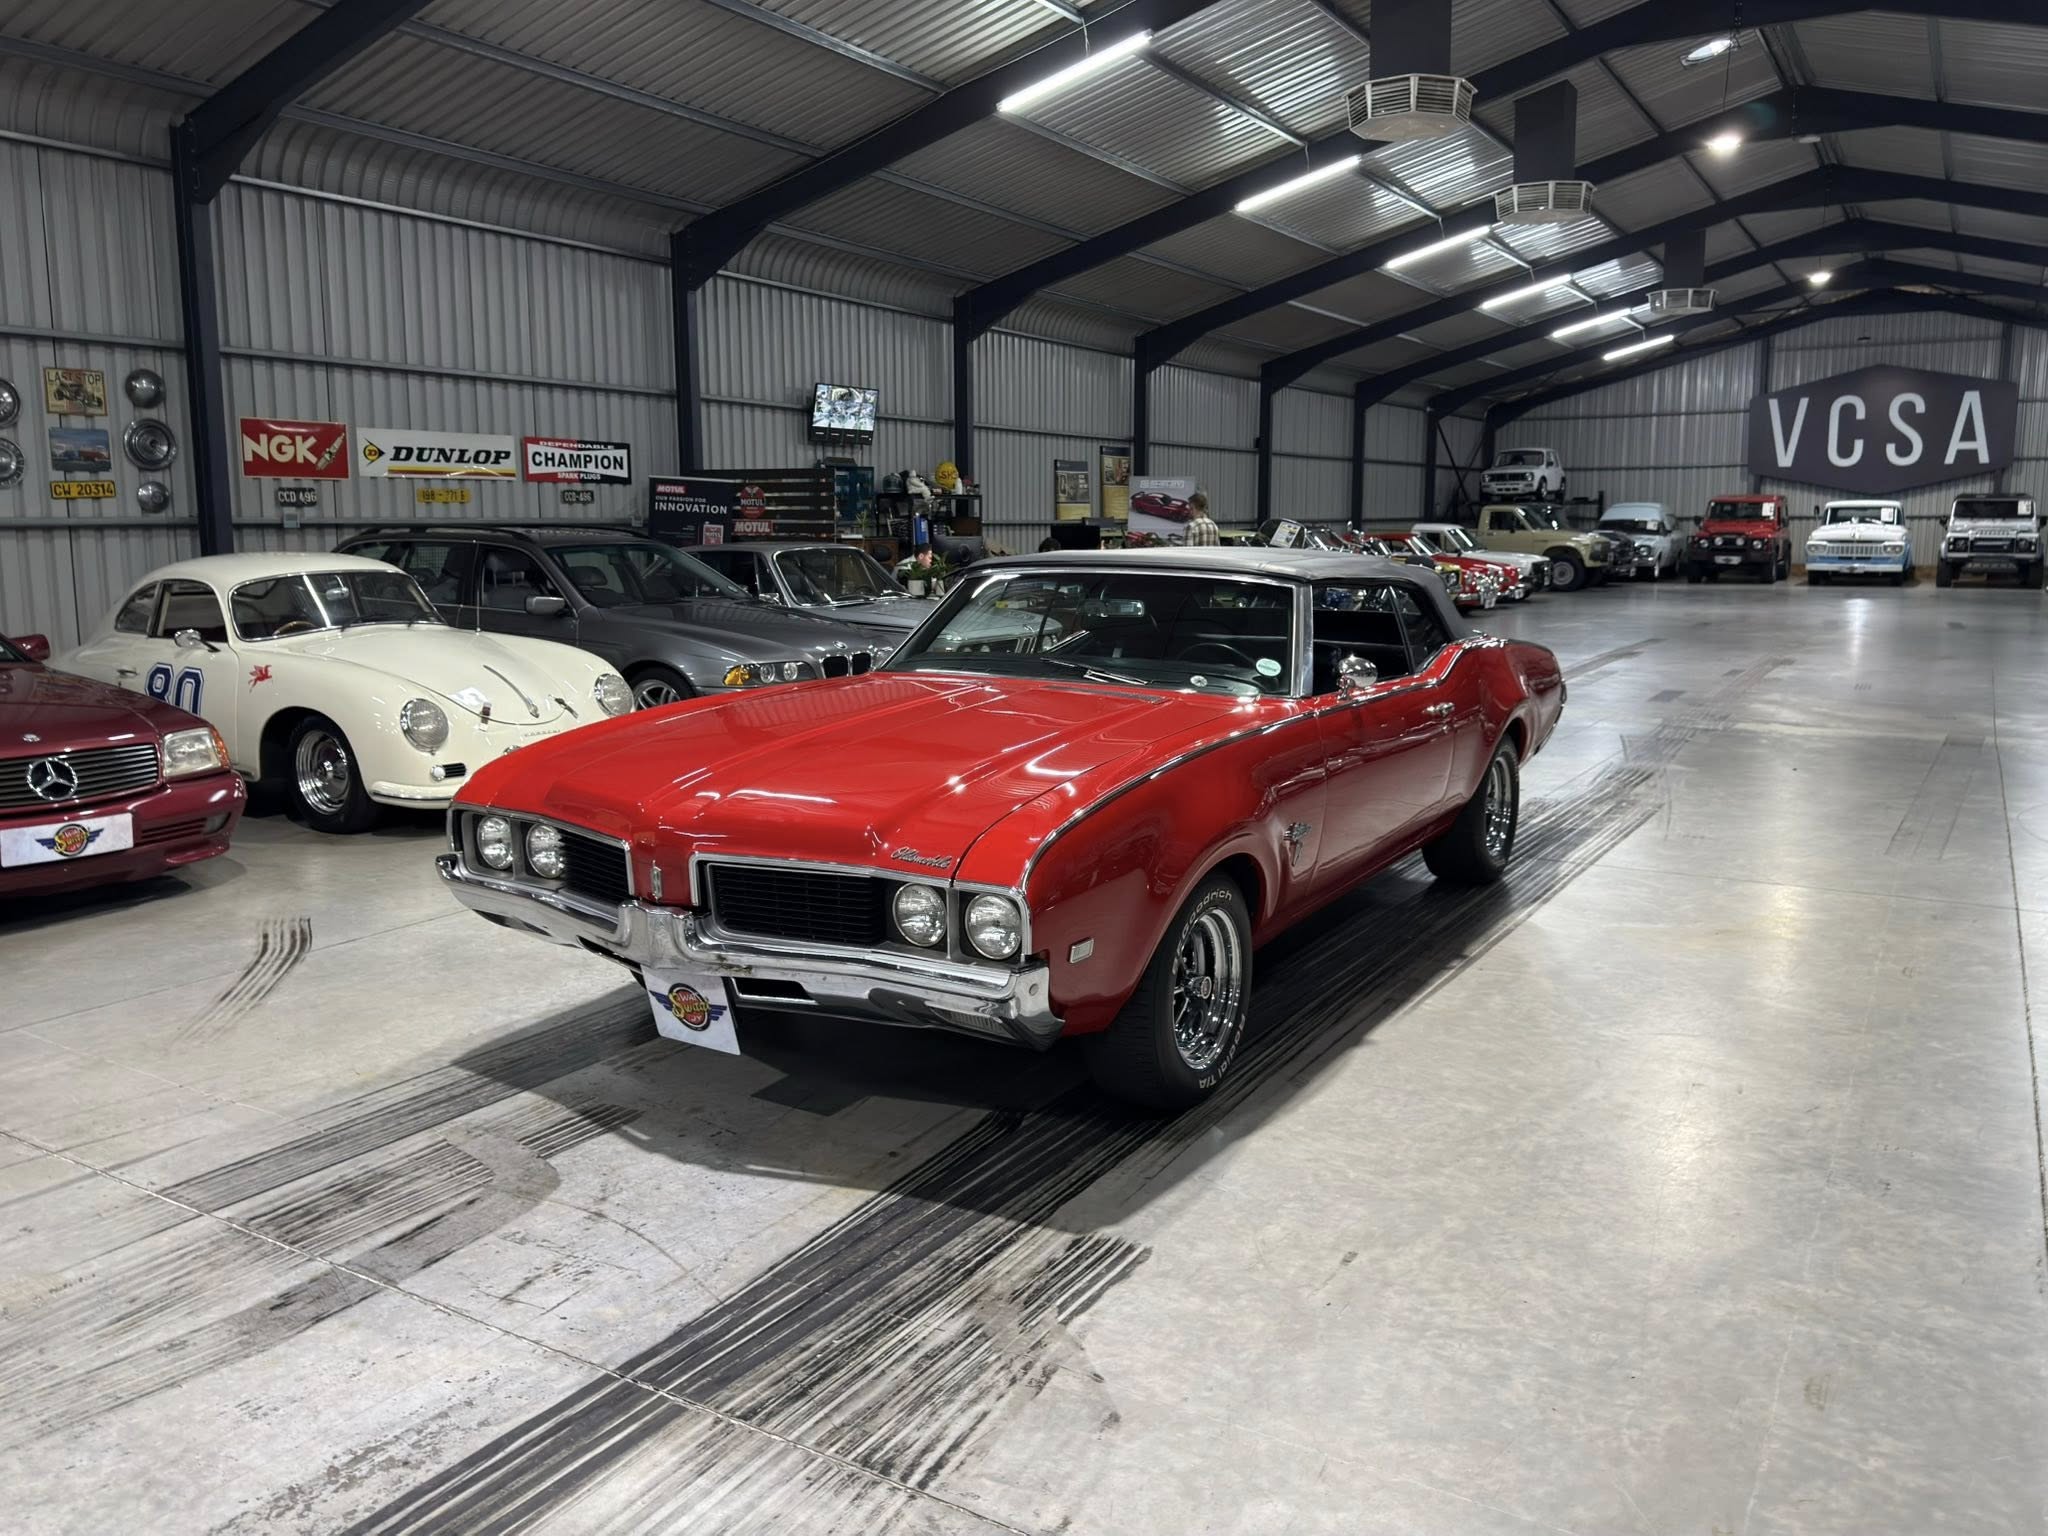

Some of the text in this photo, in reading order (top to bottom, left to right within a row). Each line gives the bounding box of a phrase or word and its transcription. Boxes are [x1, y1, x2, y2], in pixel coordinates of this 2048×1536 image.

[1768, 390, 1990, 468] VCSA
[242, 433, 318, 464] NGK
[539, 440, 616, 450] DEPENDABLE
[389, 446, 511, 465] DUNLOP
[532, 451, 624, 470] CHAMPION
[557, 472, 601, 481] SPARK PLUGS
[53, 480, 114, 497] CW 20314
[656, 484, 686, 494] MOTUL
[278, 491, 297, 503] CCD
[740, 498, 764, 506] MOTUL
[655, 501, 728, 515] INNOVATION
[734, 521, 770, 533] MOTUL
